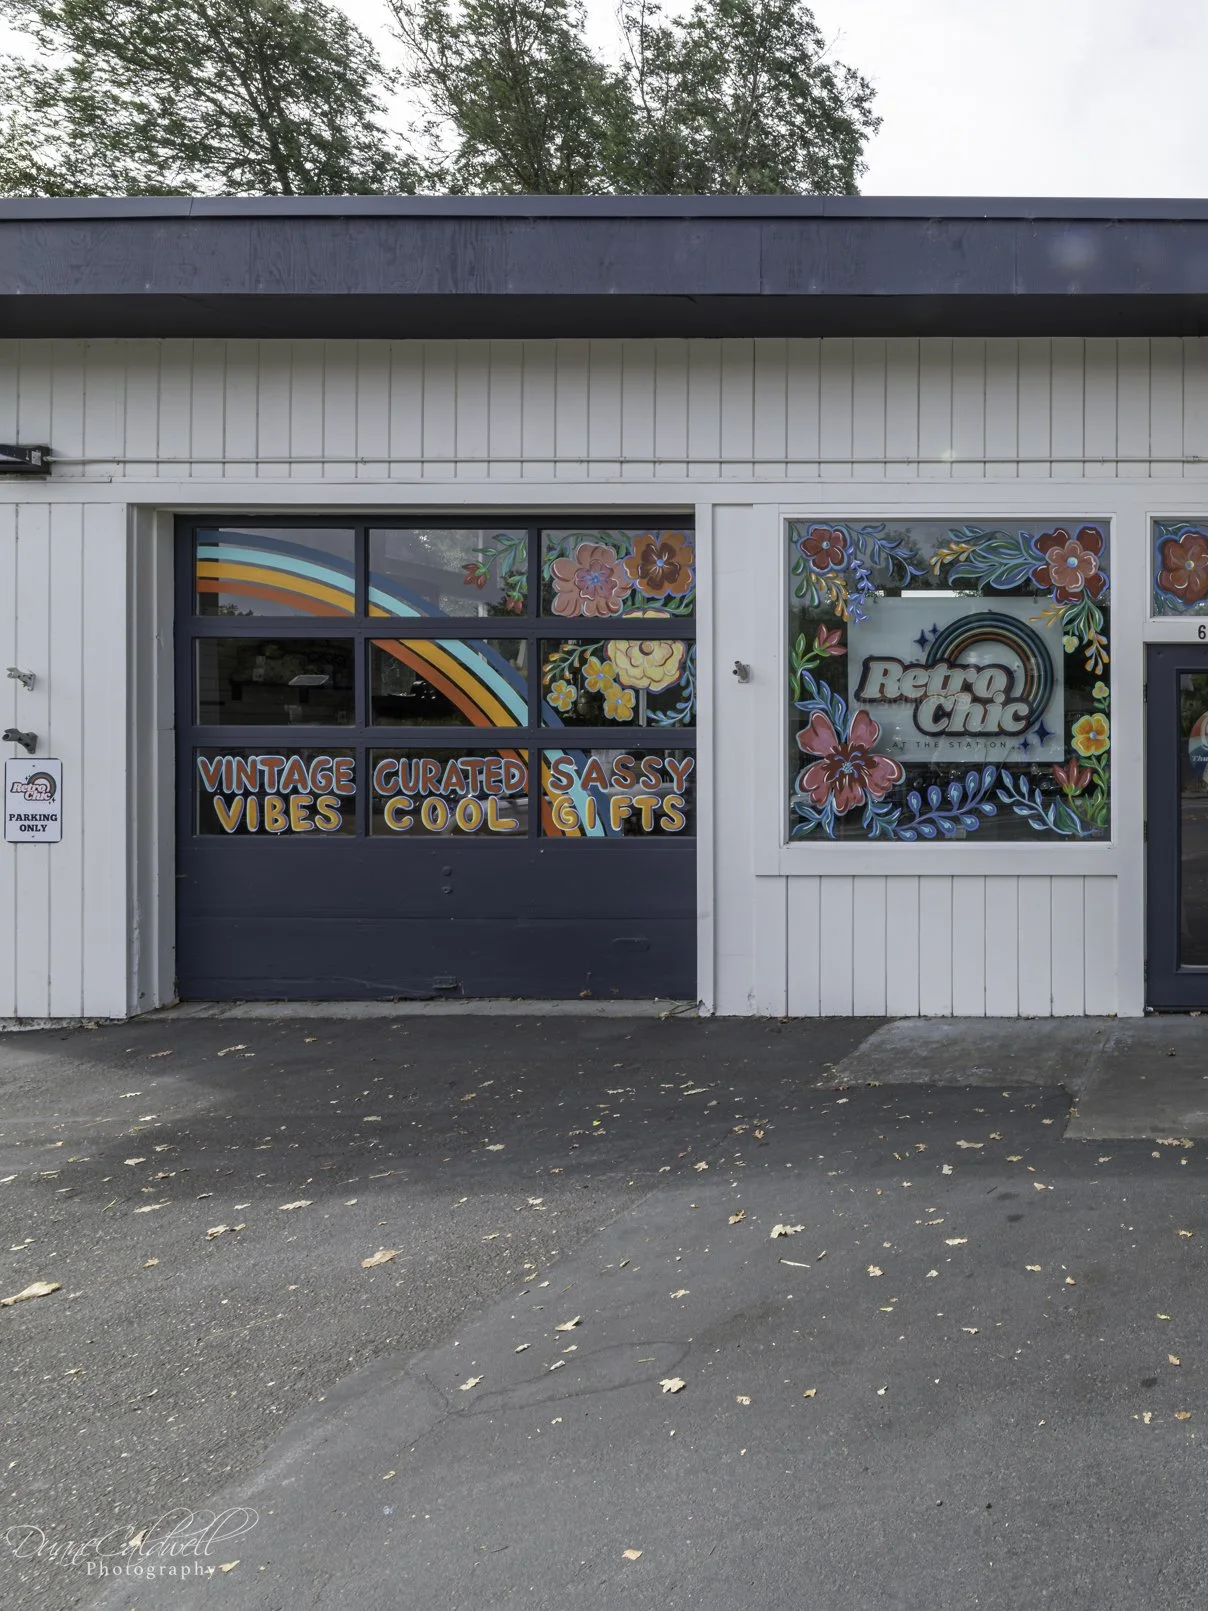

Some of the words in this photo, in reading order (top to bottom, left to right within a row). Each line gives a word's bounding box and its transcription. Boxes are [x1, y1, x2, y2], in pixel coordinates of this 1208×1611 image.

[854, 656, 1016, 703] Retro
[912, 690, 1036, 737] Chic
[892, 741, 907, 749] AT
[916, 741, 940, 749] THE
[949, 741, 1007, 749] STATION
[198, 755, 356, 794] VINTAGE
[373, 757, 528, 796] CURATED
[548, 755, 695, 793] SASSY
[10, 782, 48, 793] Retro
[24, 791, 52, 801] Chic
[9, 813, 58, 822] PARKING
[213, 795, 342, 833] VIBES
[384, 795, 519, 832] COOL
[552, 795, 686, 832] GIFTS
[19, 824, 48, 832] ONLY
